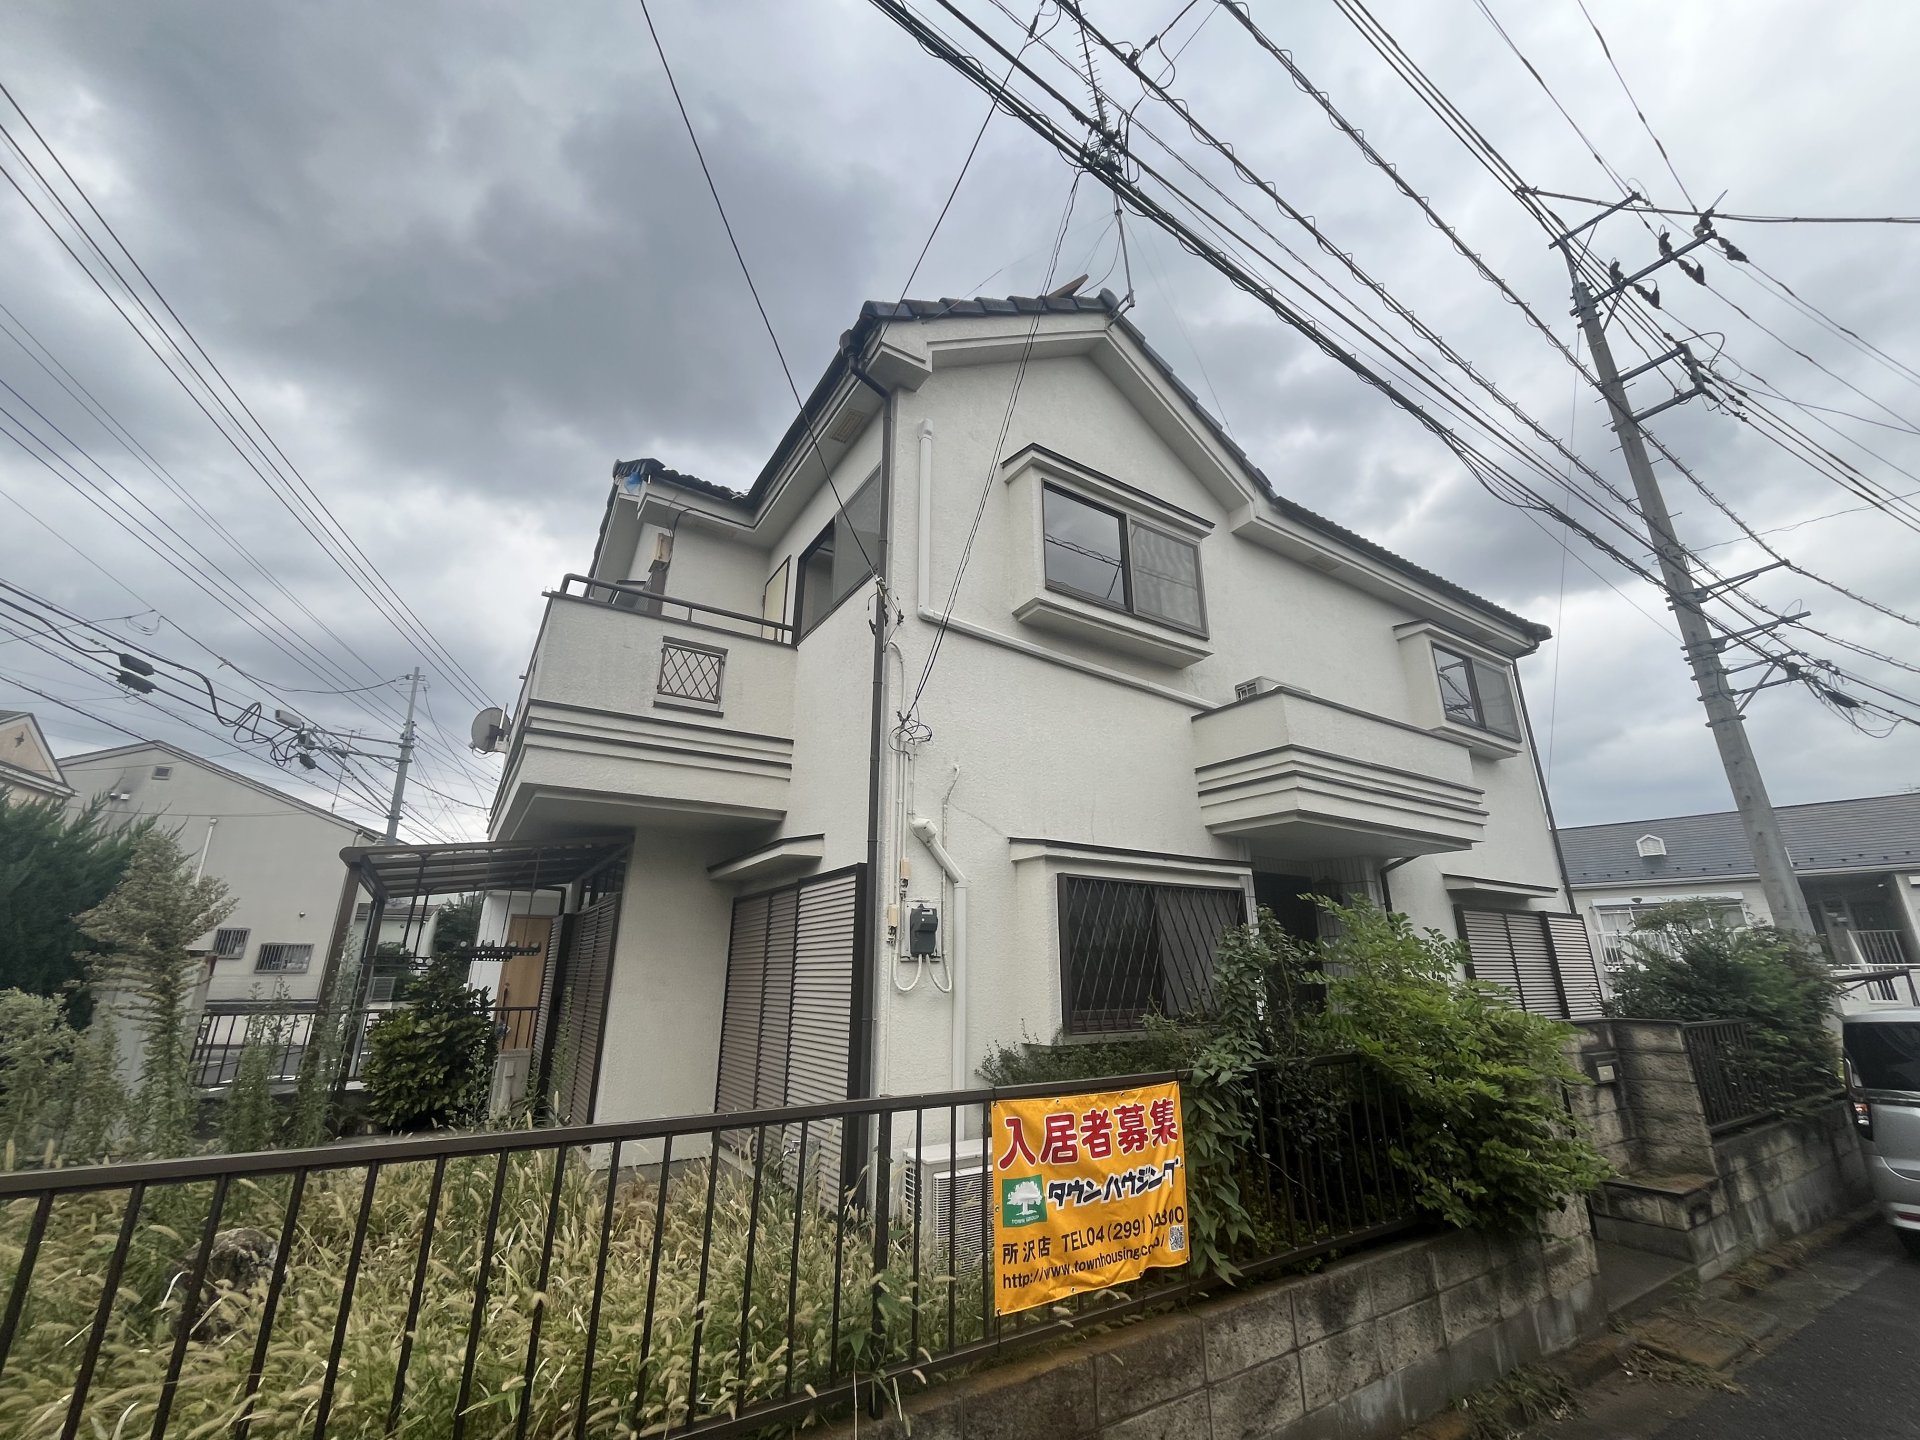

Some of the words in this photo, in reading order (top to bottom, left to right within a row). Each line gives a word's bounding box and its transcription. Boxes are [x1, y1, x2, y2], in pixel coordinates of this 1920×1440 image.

[998, 1098, 1178, 1170] 入居者募集
[1048, 1158, 1180, 1208] タウンハウジング
[1002, 1236, 1051, 1265] 所沢店
